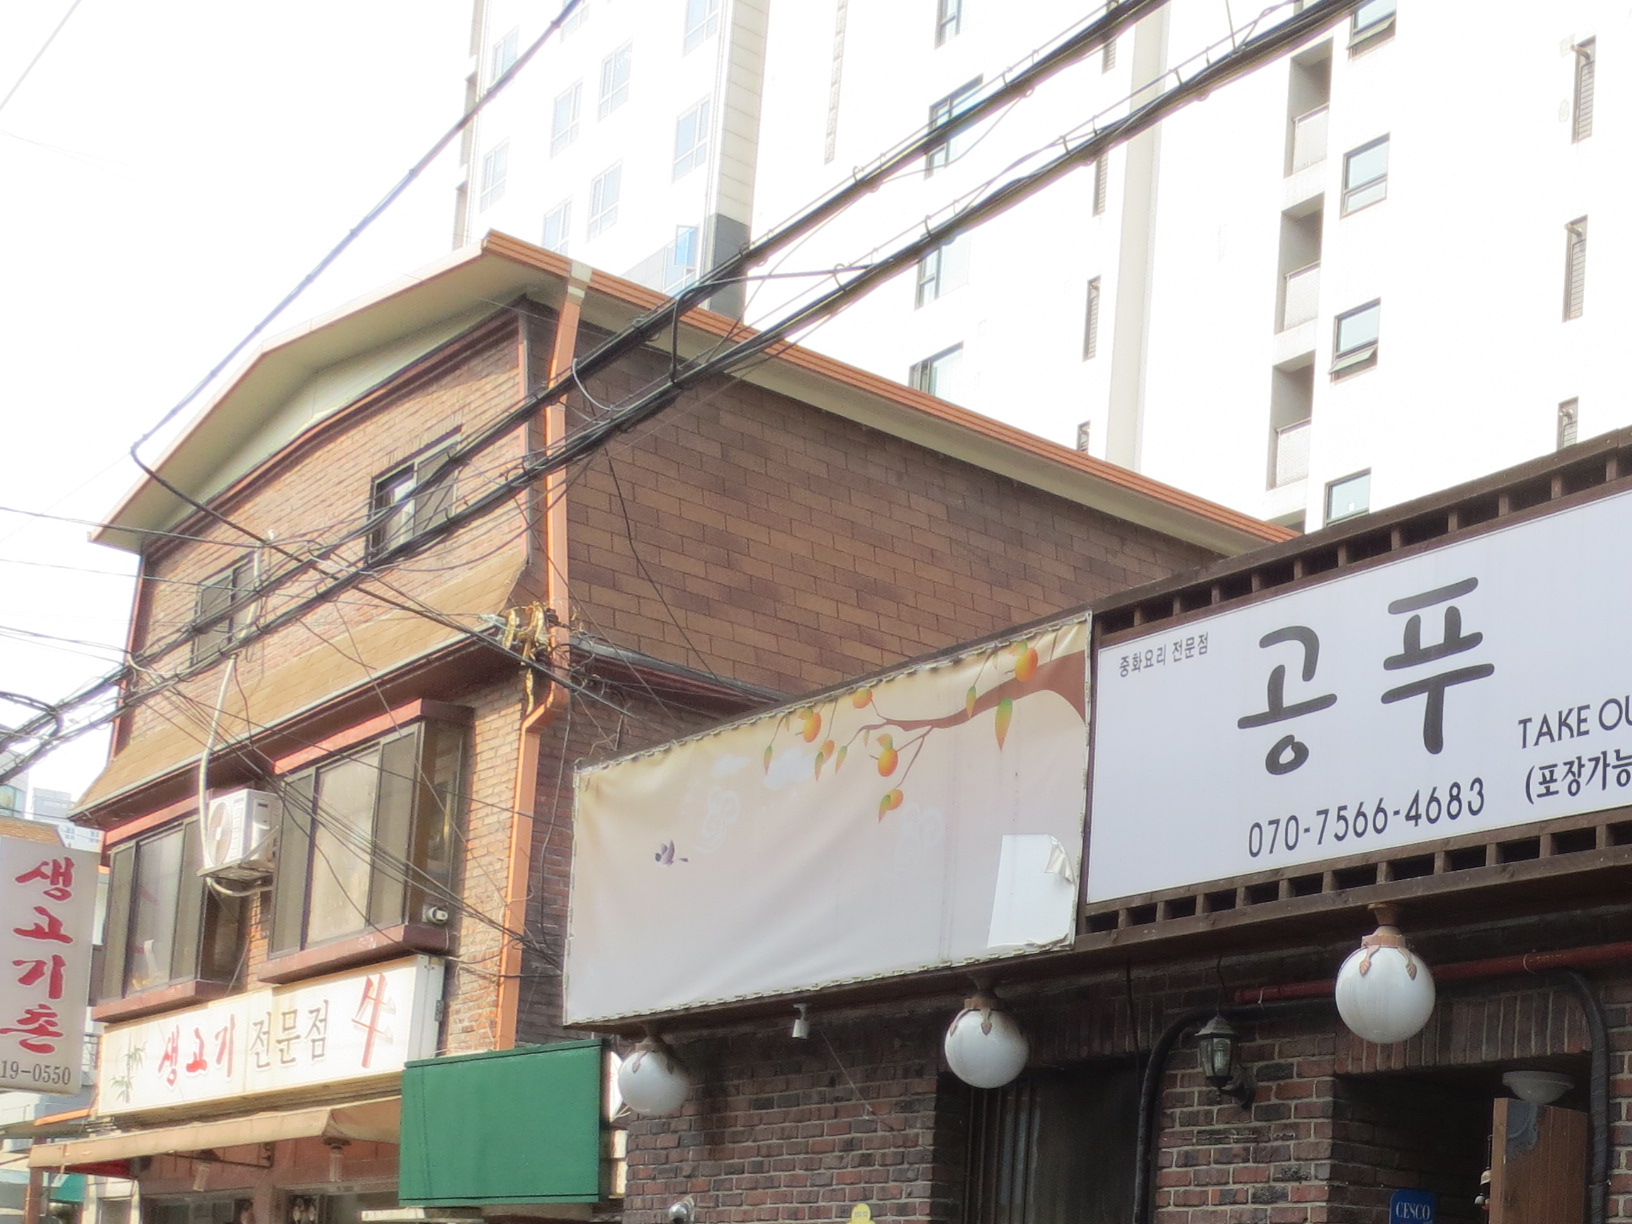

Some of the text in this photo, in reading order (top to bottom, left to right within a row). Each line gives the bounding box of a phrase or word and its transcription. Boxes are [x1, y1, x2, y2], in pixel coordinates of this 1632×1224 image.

[1119, 631, 1209, 678] 중화요리 전문점
[1517, 704, 1591, 752] TAKE
[1247, 777, 1487, 860] 070-7566-4683
[158, 1013, 236, 1087] 생고기
[250, 999, 330, 1070] 전문점
[1395, 1201, 1431, 1220] CESCO
